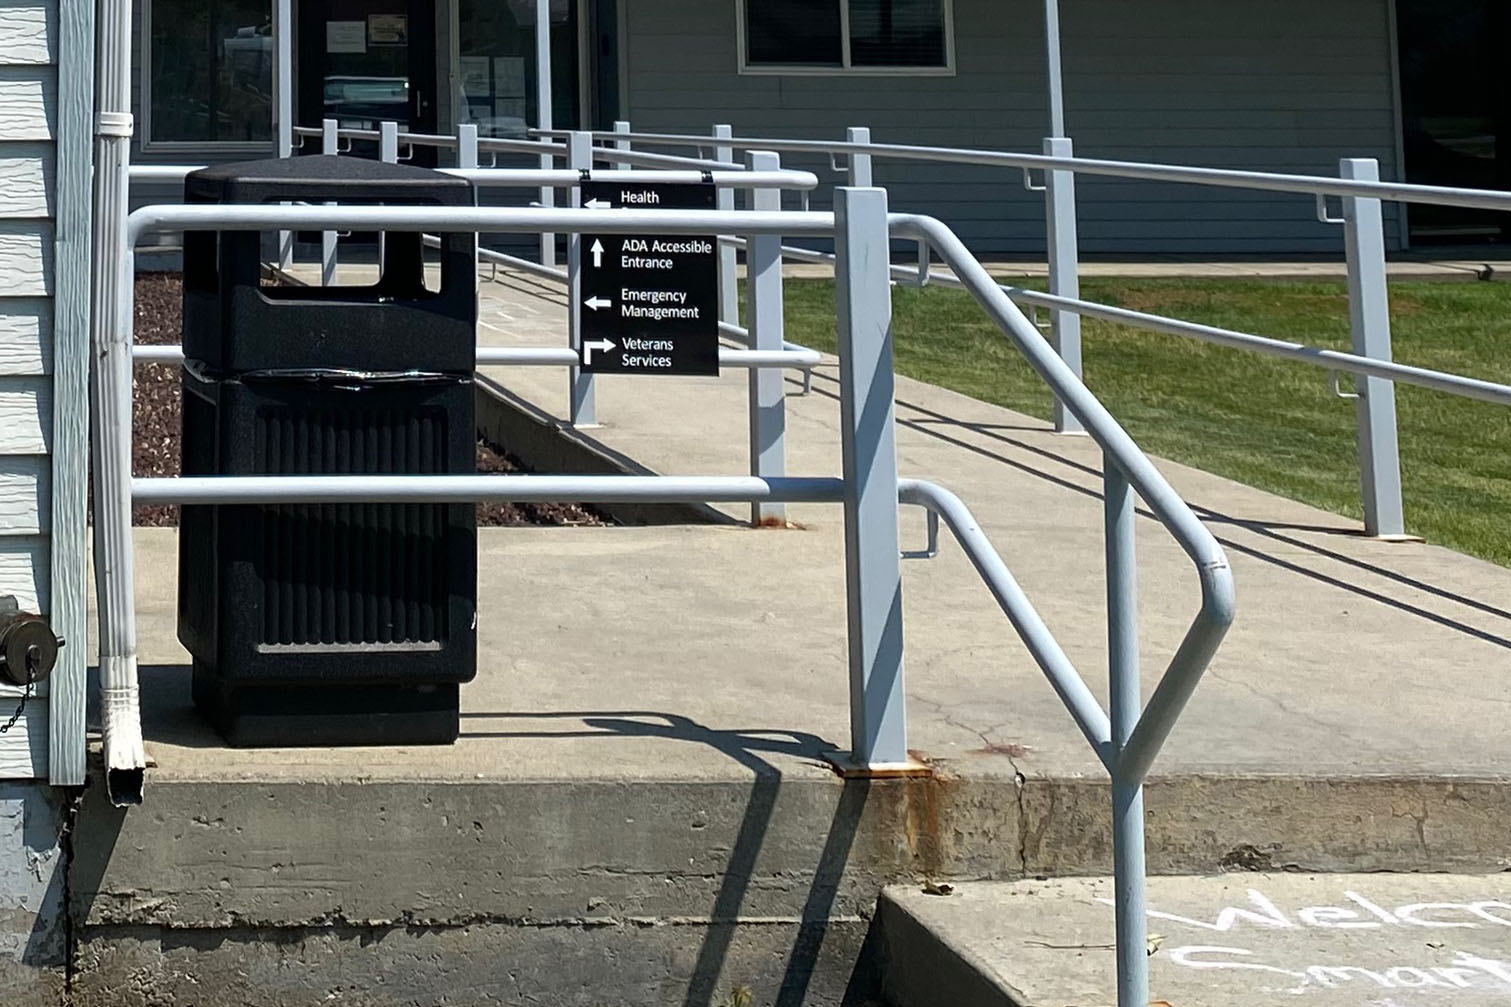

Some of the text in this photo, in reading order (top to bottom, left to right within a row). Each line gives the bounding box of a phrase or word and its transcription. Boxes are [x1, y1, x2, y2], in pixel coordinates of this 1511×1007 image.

[621, 190, 660, 204] Health
[621, 239, 713, 254] ADA Accessible
[621, 256, 673, 269] Entrance
[621, 288, 687, 304] Emergency
[621, 304, 700, 320] Management
[622, 337, 674, 351] Veterans
[621, 353, 672, 367] Services
